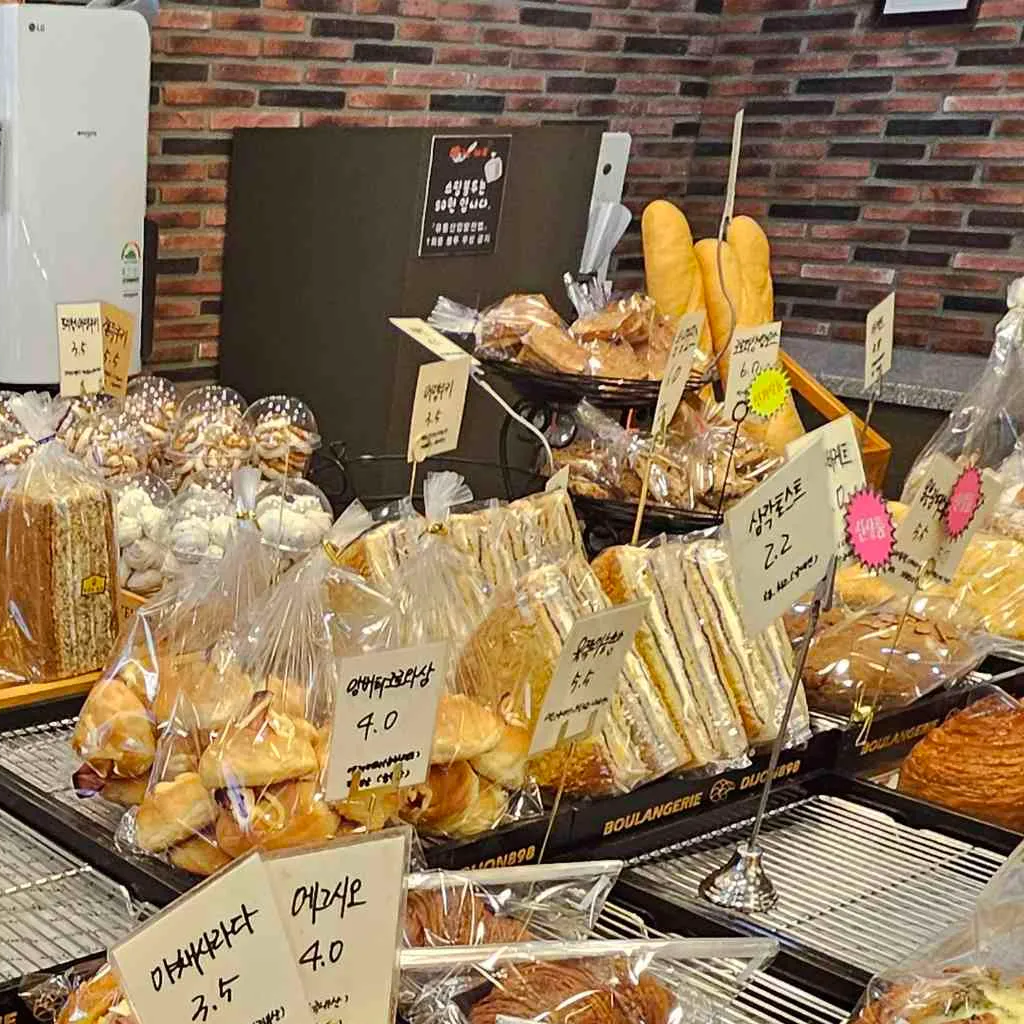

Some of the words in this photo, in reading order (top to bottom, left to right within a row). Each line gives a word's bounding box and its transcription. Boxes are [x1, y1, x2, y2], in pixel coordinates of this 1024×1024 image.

[764, 533, 793, 571] 2.2
[570, 668, 596, 695] 5.5
[356, 710, 399, 742] 4.0
[602, 791, 704, 837] BOULANGERIE
[149, 903, 260, 993] 야채사라다
[298, 939, 345, 973] 4.0
[190, 973, 241, 1024] 3.5
